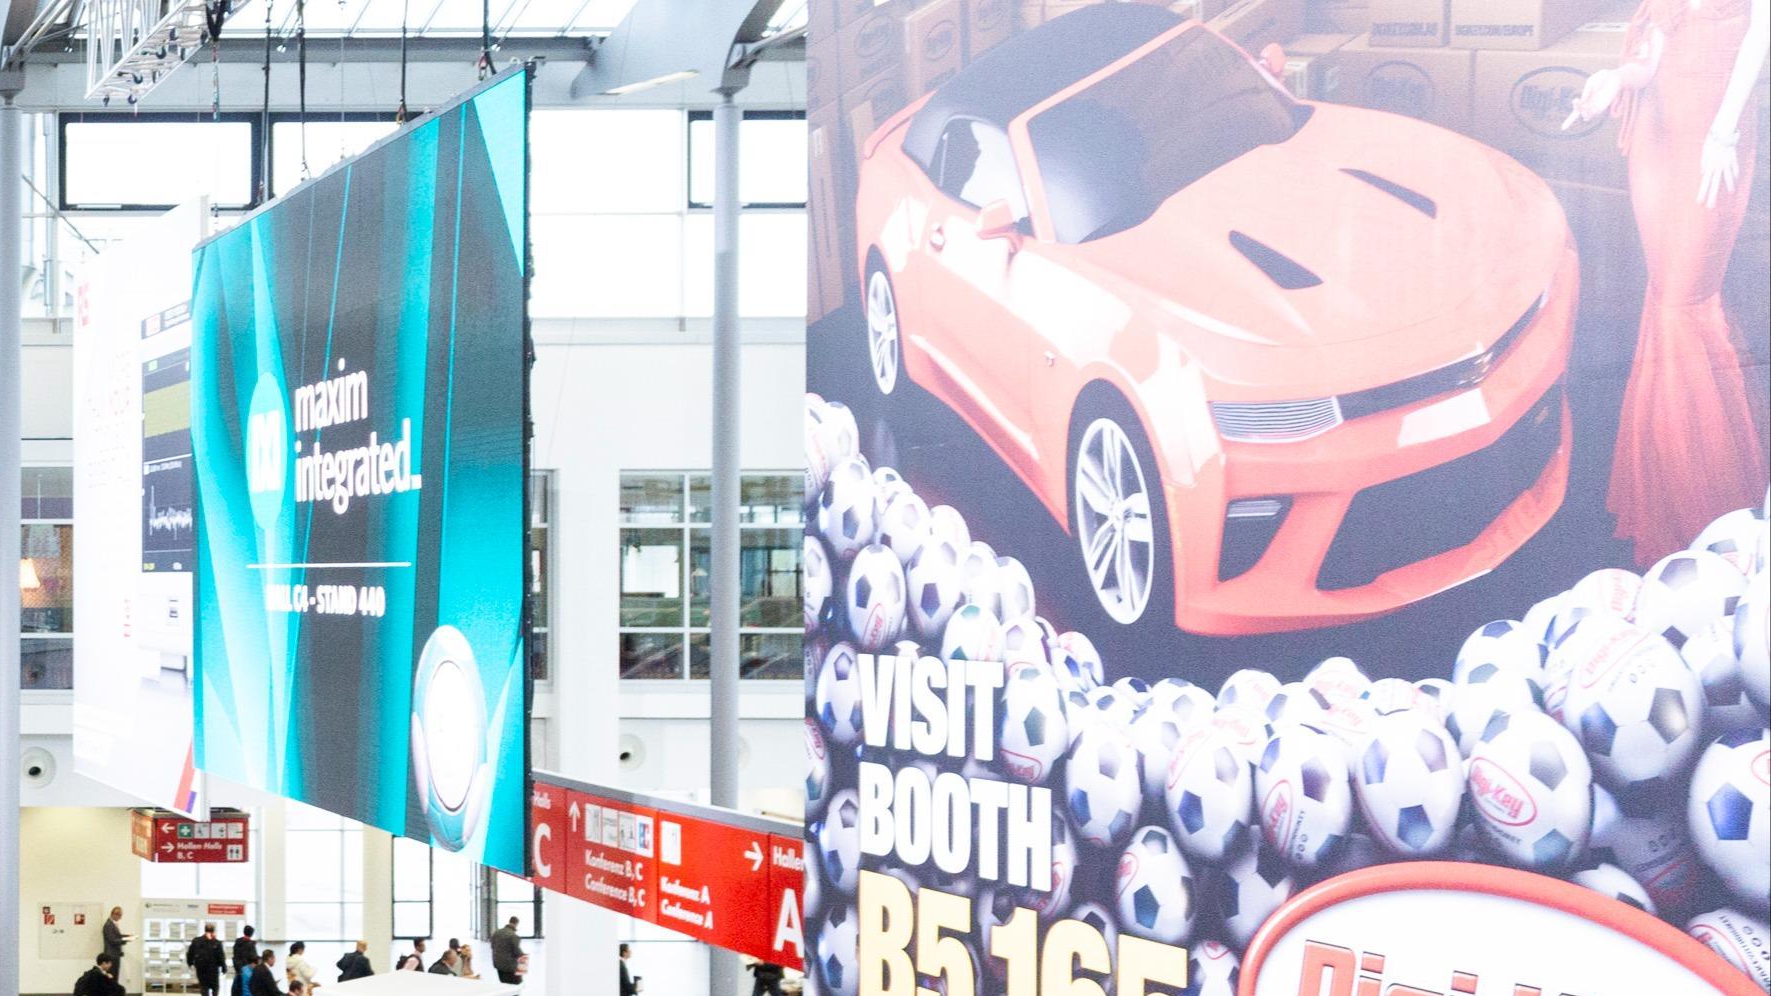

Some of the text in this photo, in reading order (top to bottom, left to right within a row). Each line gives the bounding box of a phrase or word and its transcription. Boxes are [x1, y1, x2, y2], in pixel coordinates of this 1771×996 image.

[295, 357, 368, 433] maxim
[358, 585, 386, 618] 440
[857, 653, 1004, 761] VISIT
[534, 822, 552, 878] C
[859, 761, 1052, 892] BOOTH
[700, 885, 711, 905] A
[704, 911, 713, 930] A
[773, 887, 805, 959] A
